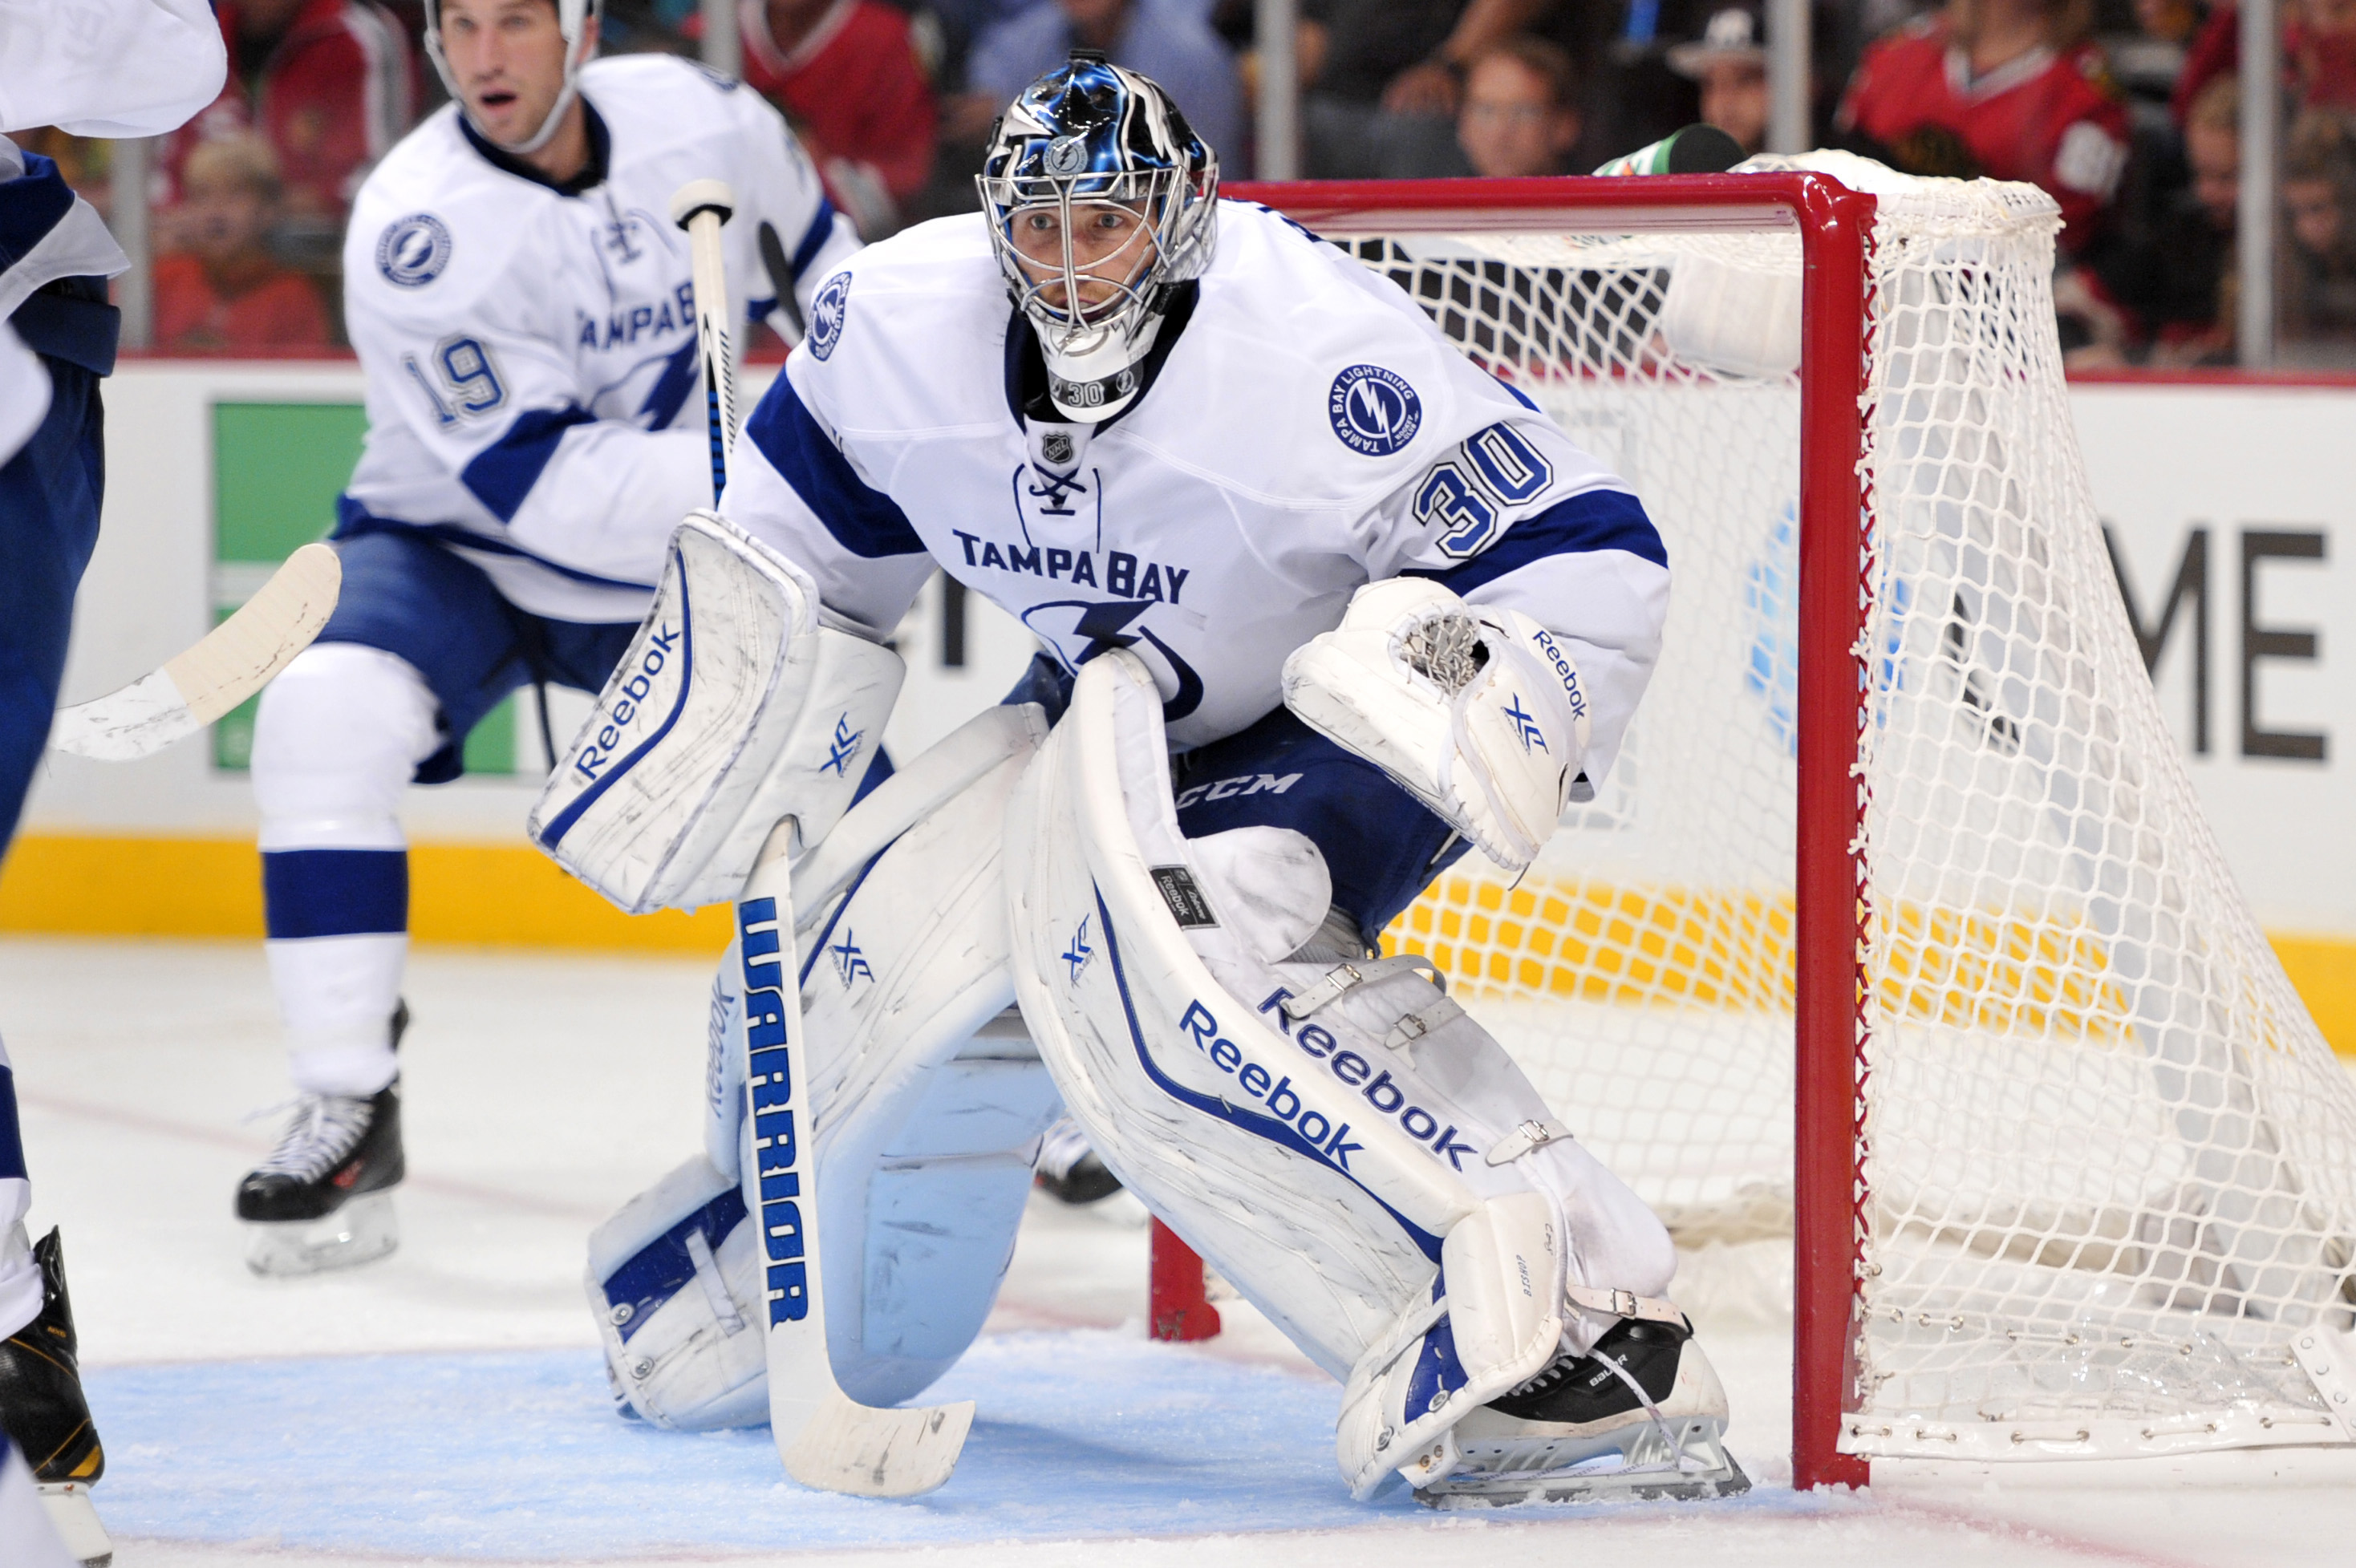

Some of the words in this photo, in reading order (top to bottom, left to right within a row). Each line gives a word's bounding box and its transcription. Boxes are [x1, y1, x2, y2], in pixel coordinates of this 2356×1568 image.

[403, 334, 508, 430] 19
[1068, 380, 1105, 407] 30
[1332, 384, 1346, 414] BAY
[1340, 366, 1415, 400] LIGHTNING
[1336, 417, 1381, 453] TAMPA
[1394, 414, 1414, 440] HOCKEY
[1047, 440, 1068, 459] NHL
[1413, 420, 1554, 559] 30
[952, 529, 1099, 590] TAMPA
[1106, 550, 1190, 605] BAY
[1532, 630, 1587, 722] Reebok
[574, 620, 681, 781] Reebok
[1176, 772, 1304, 811] CCM
[1161, 875, 1190, 917] Reebok
[1178, 998, 1366, 1172] Reebok
[1257, 986, 1479, 1173] Reebok
[738, 896, 809, 1333] WARRIOR
[1515, 1254, 1533, 1298] BISHOP
